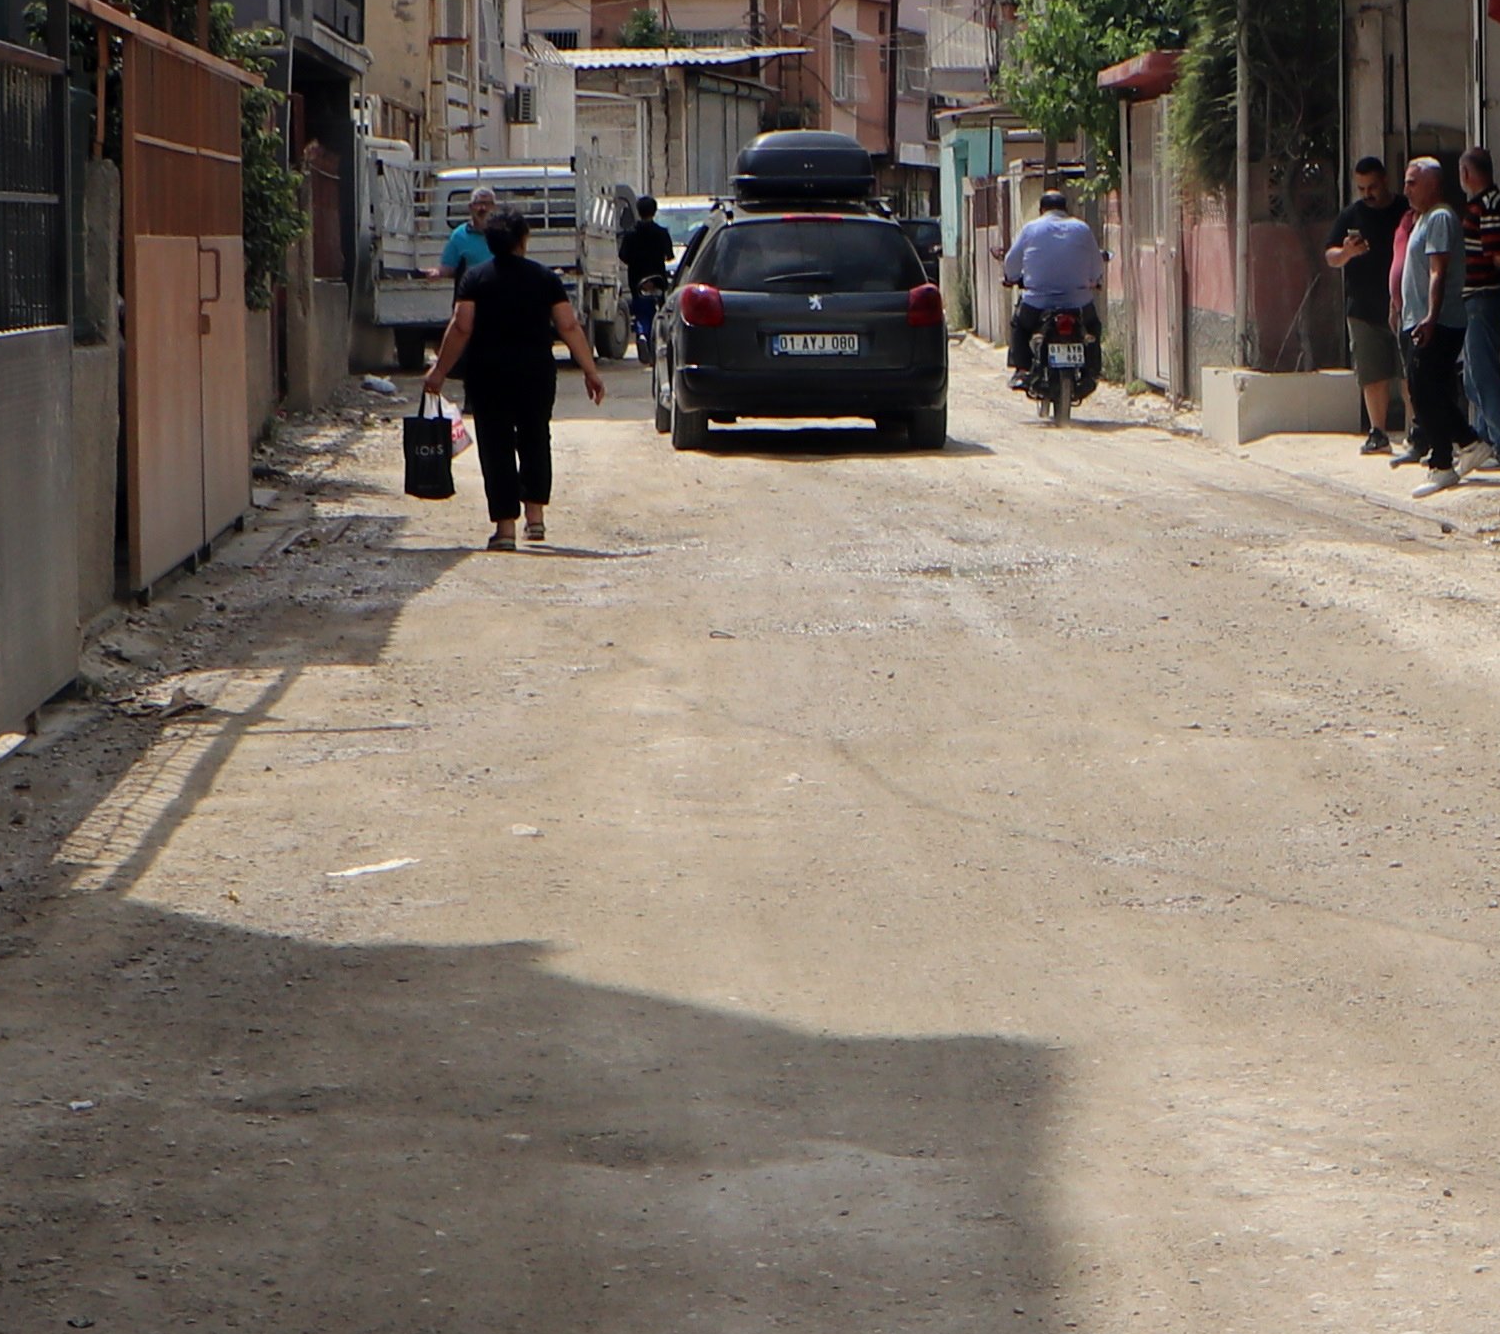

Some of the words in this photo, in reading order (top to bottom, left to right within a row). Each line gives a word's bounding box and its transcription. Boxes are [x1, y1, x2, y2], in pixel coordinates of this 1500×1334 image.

[780, 336, 795, 350] 01
[802, 336, 826, 350] AYJ
[831, 336, 855, 350] 080
